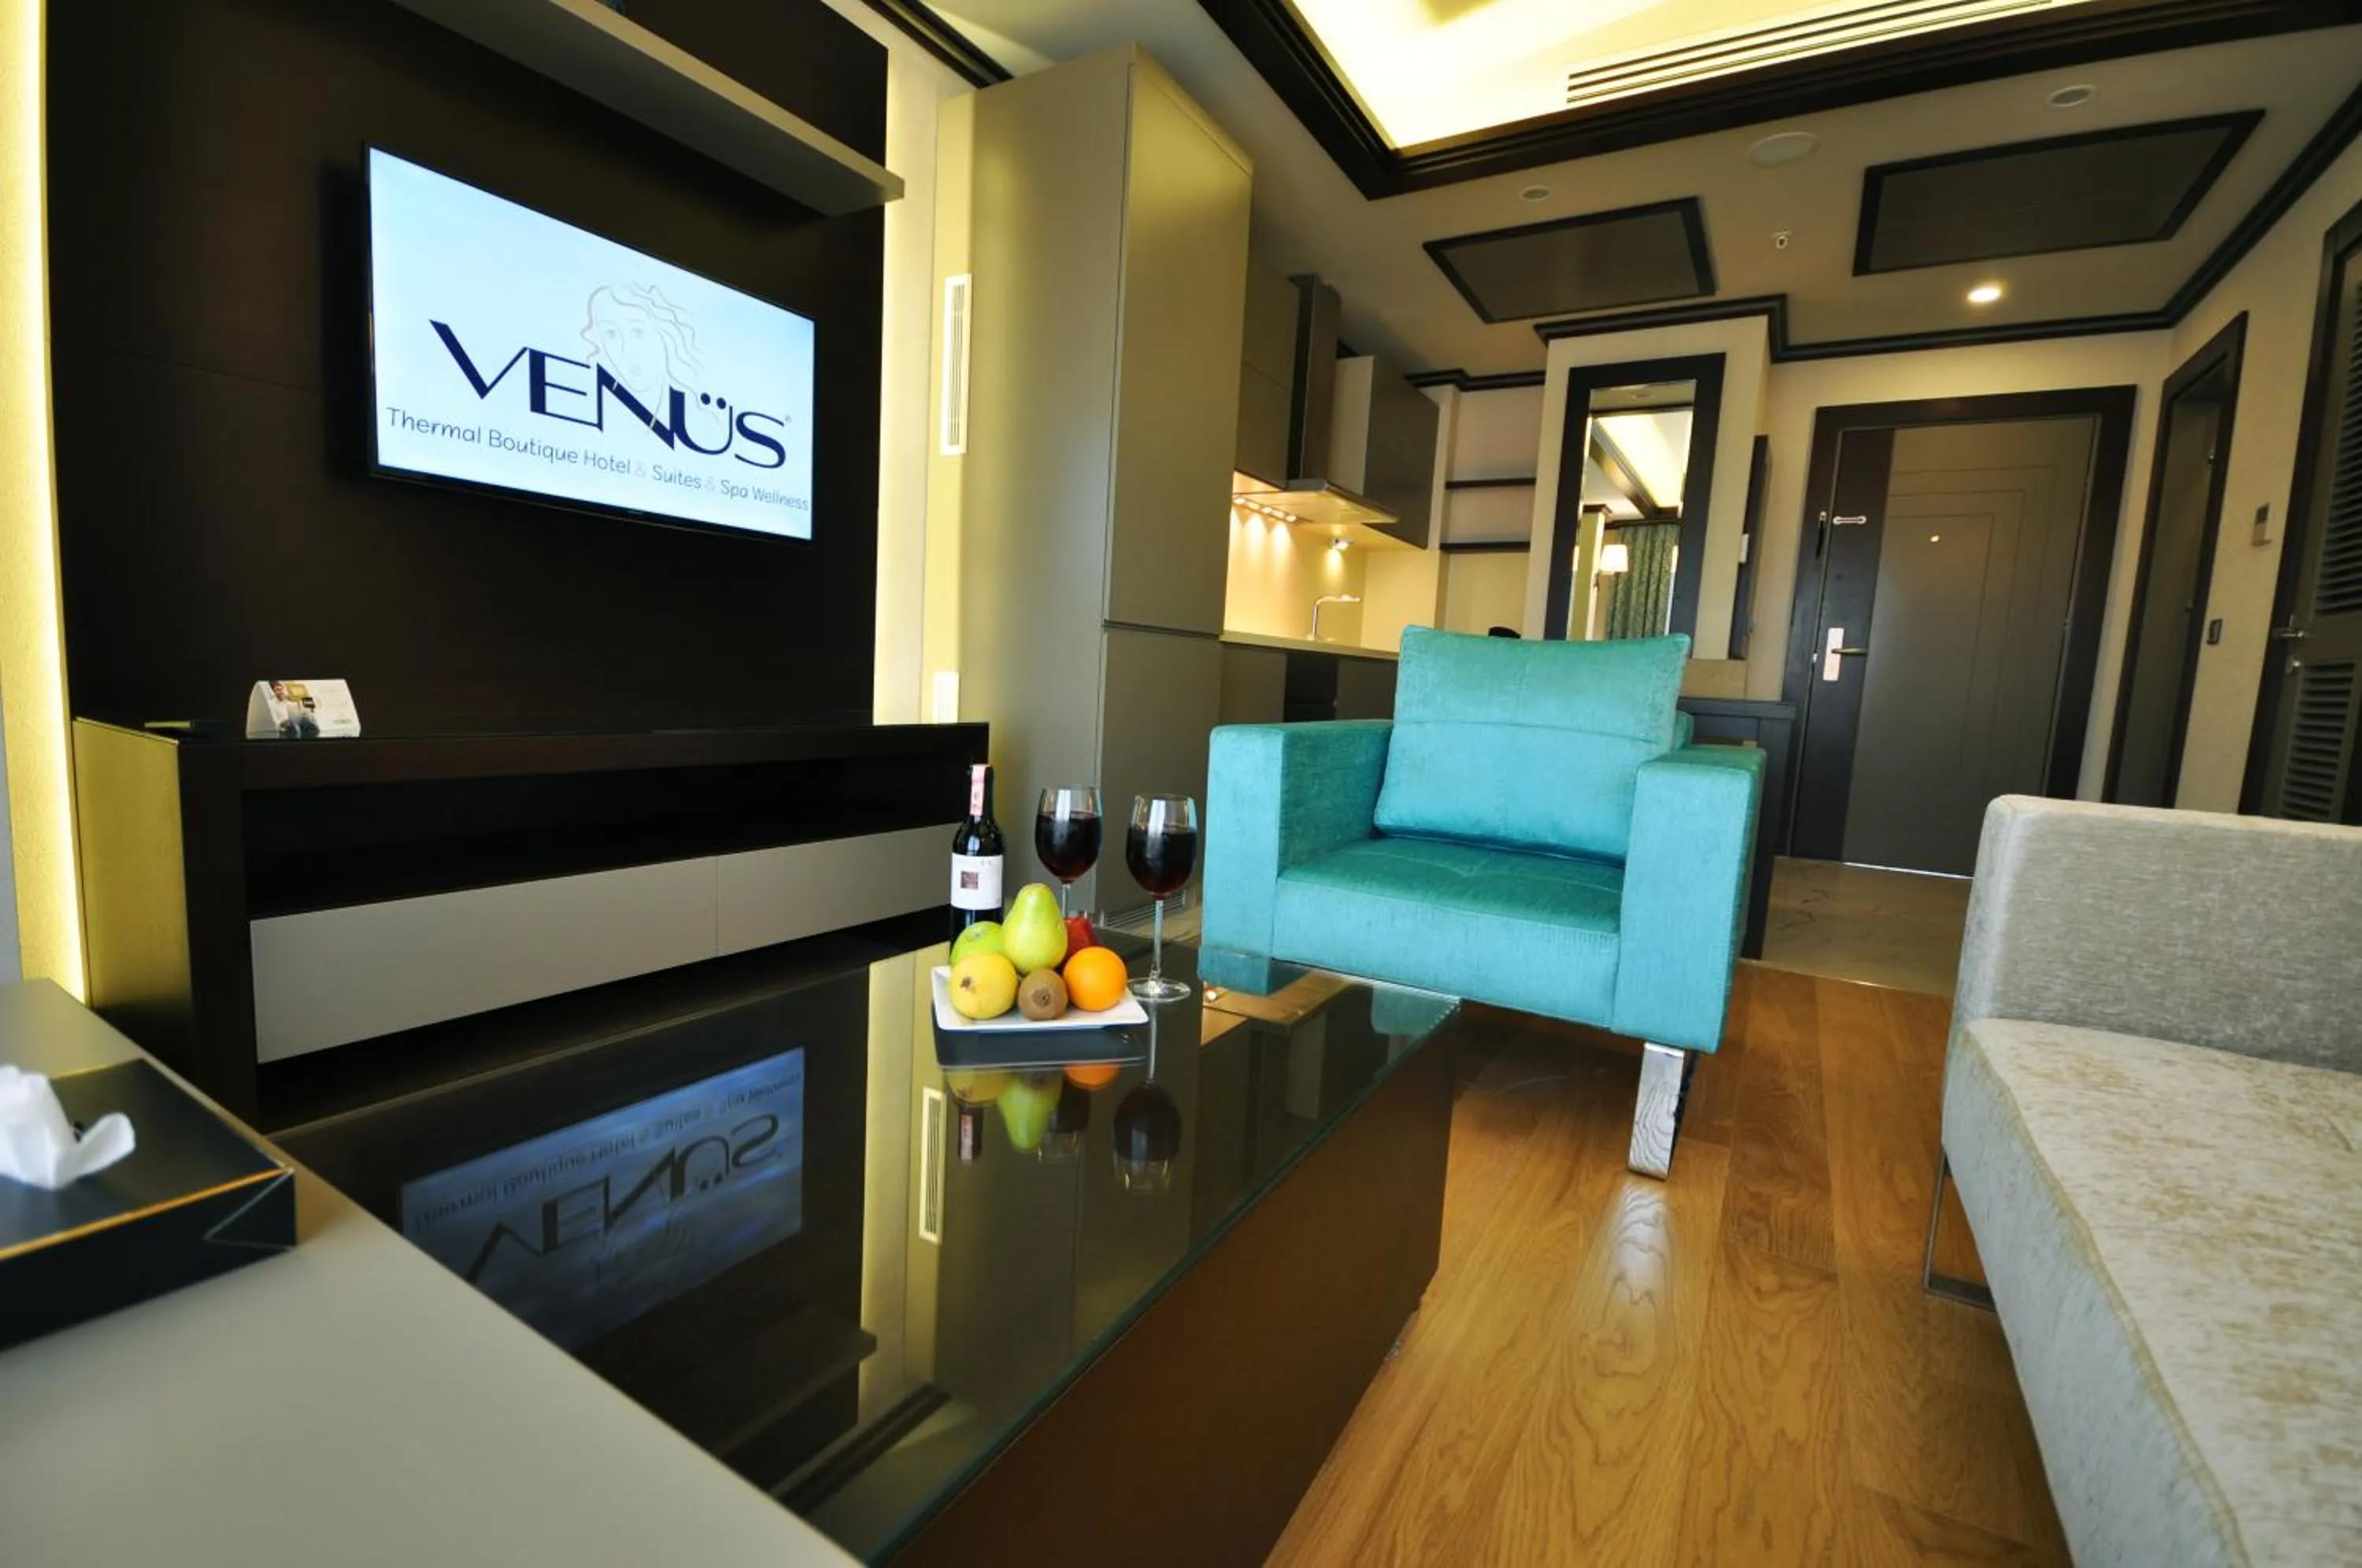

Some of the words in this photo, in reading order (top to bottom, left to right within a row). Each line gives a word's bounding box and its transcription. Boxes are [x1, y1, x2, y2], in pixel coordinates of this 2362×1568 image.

[429, 318, 787, 469] VENÜS
[386, 406, 482, 444] Thermal
[488, 429, 579, 464] Boutique
[583, 450, 631, 474] Hotel
[652, 465, 702, 490] Suites
[720, 479, 749, 499] Spa
[752, 485, 809, 512] Wellness
